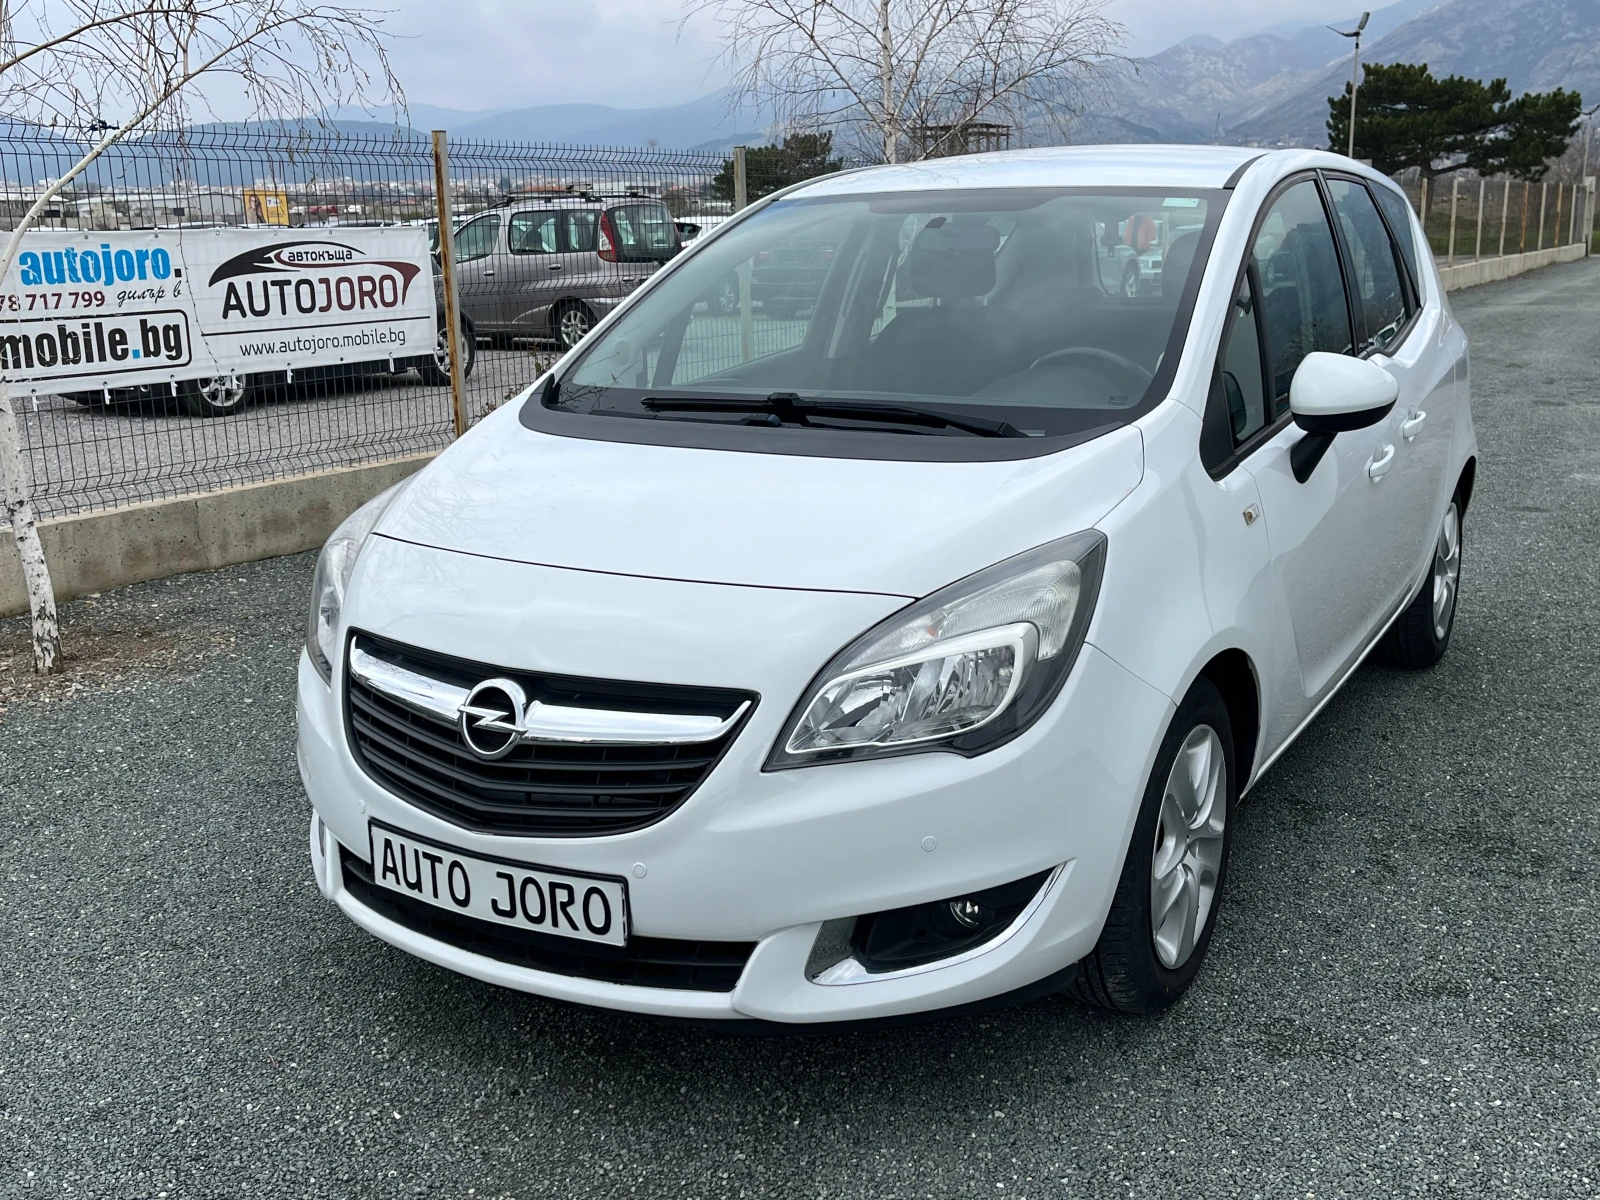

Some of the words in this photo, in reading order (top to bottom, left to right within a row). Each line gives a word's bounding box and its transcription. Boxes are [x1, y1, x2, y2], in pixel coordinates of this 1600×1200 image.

[19, 243, 182, 286] autojoro.
[287, 249, 353, 262] автокъща
[25, 292, 63, 311] 717
[68, 290, 105, 310] 799
[221, 274, 399, 319] AUTOJORO
[0, 318, 183, 370] mobile.bg
[240, 327, 406, 356] www.autojoro.mobile.bg
[381, 837, 471, 908] AUTO
[490, 871, 612, 936] JORO
